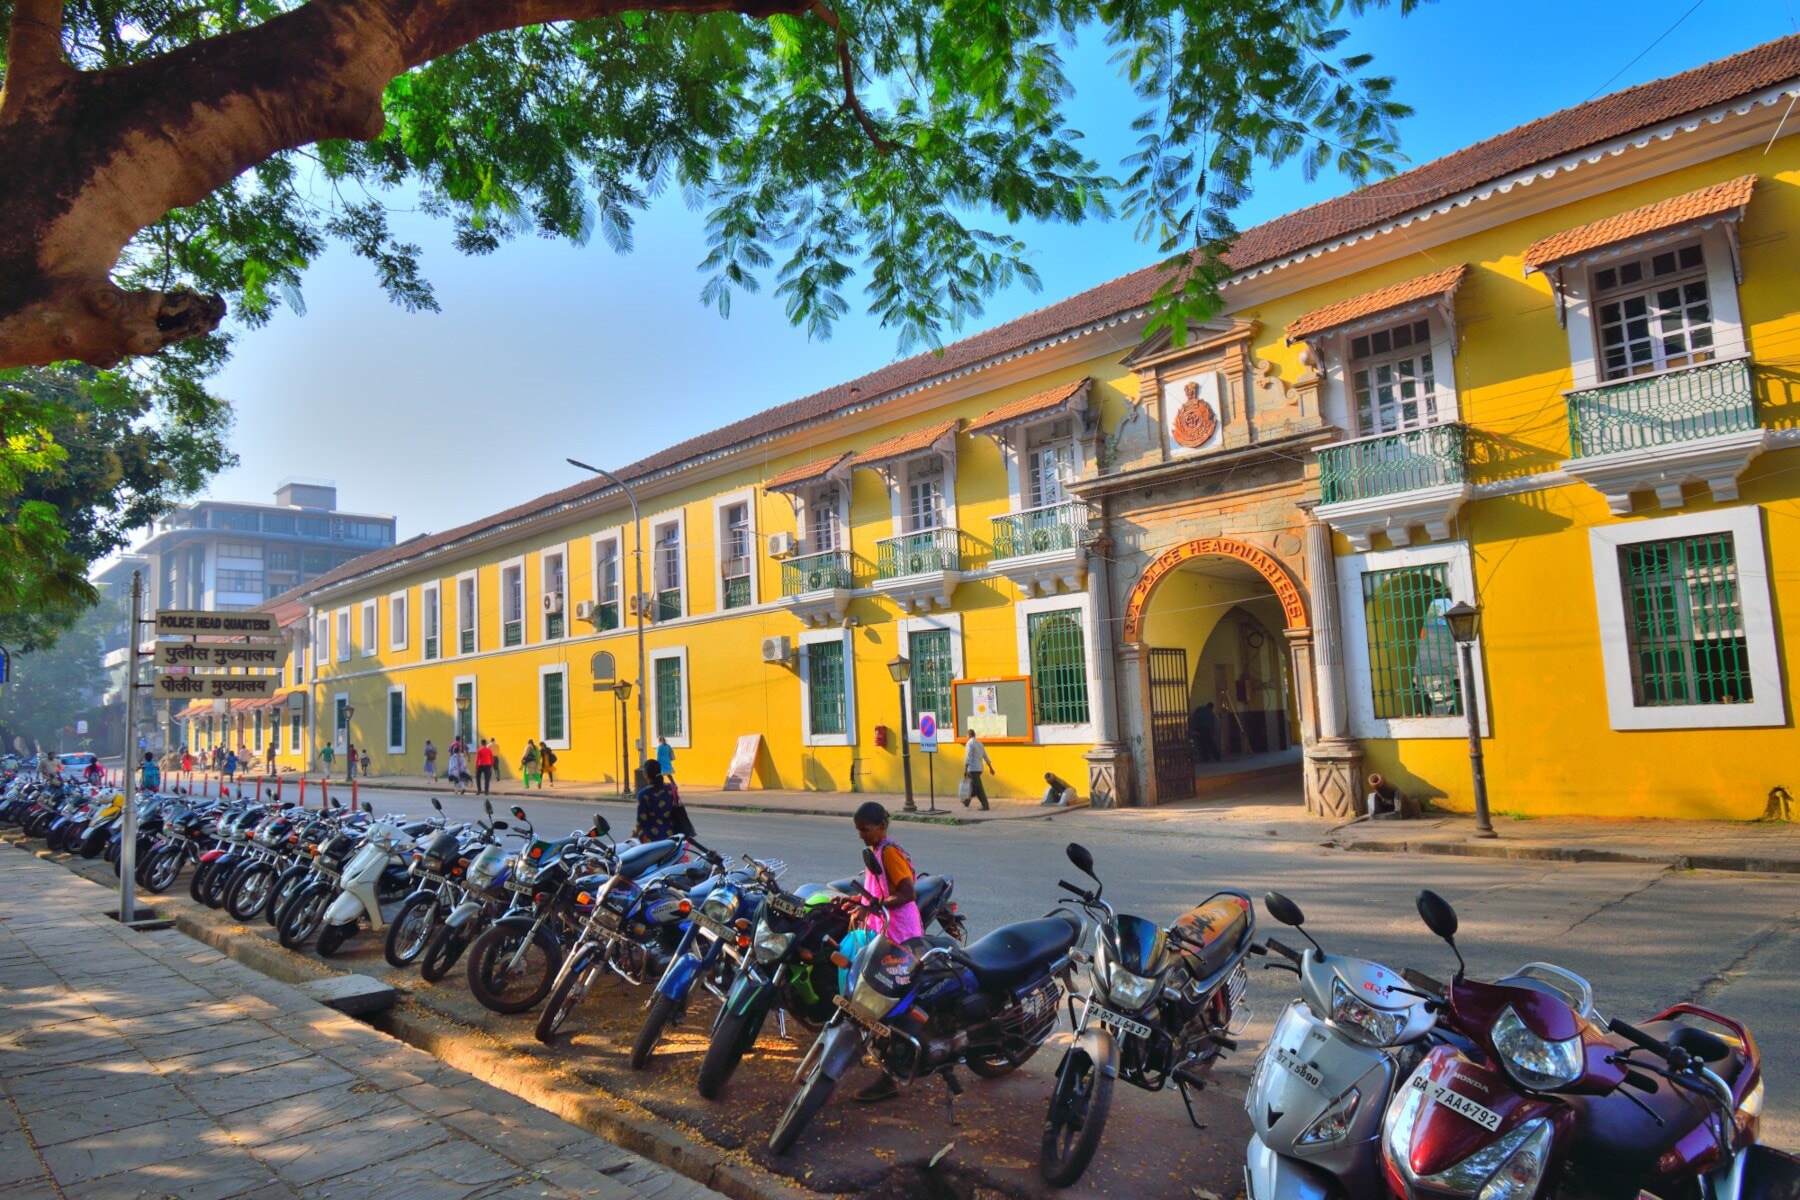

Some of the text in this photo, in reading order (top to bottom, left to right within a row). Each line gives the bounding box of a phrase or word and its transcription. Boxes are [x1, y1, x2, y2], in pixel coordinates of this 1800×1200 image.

[1125, 539, 1302, 634] GOA POLICE HEADQUARTERS
[160, 616, 270, 631] POLICE HEAD QUARTERS
[165, 644, 277, 665] पुलीस मुख्यालय
[161, 675, 267, 696] पोलीस मुख्यालय
[1288, 1060, 1295, 1068] Y
[1294, 1065, 1319, 1086] 5890
[1413, 1076, 1429, 1091] GA
[1454, 1072, 1489, 1093] HONDA
